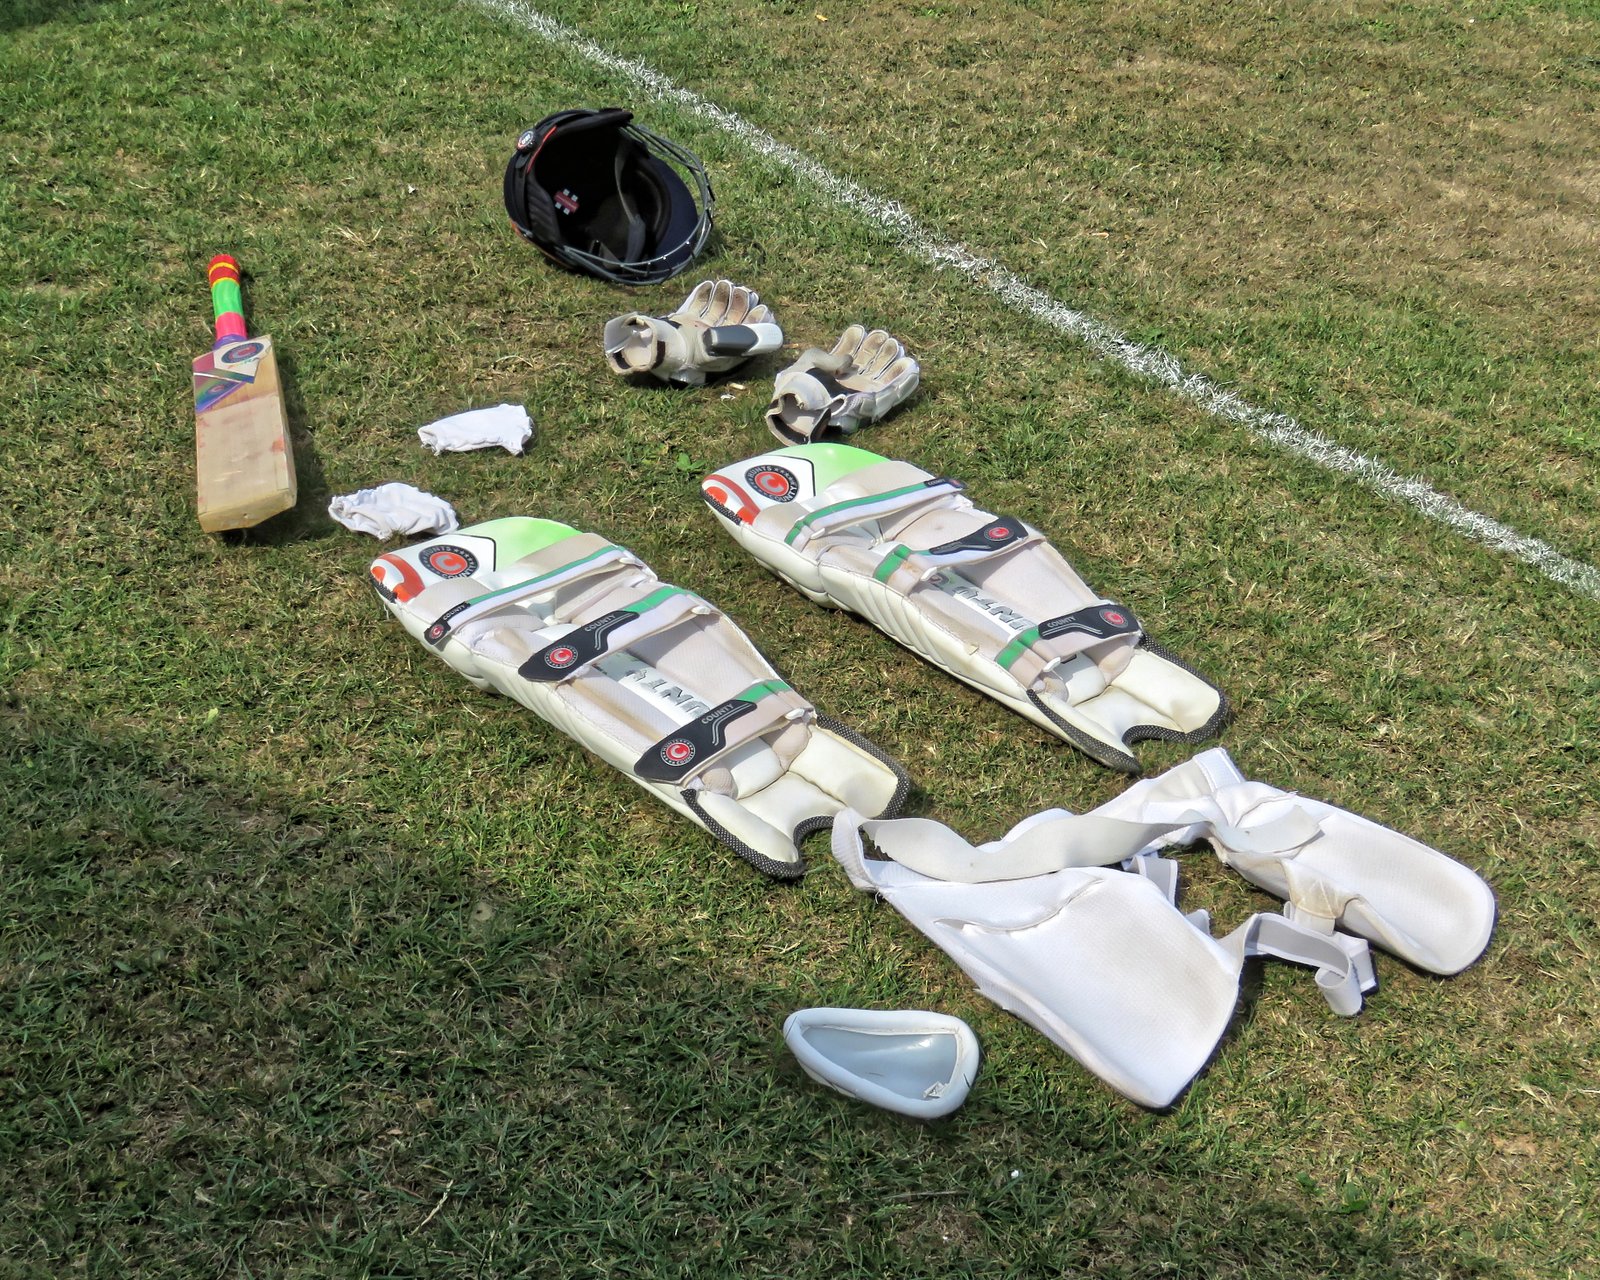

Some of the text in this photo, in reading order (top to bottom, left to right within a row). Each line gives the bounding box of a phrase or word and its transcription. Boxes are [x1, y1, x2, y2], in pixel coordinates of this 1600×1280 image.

[746, 465, 772, 478] HUNTS
[769, 484, 798, 502] COUNTY
[442, 603, 466, 620] COUNTY
[584, 614, 617, 632] COUNTY
[1046, 615, 1077, 628] COUNTY
[625, 668, 711, 719] UNTY
[701, 703, 734, 724] COUNTY
